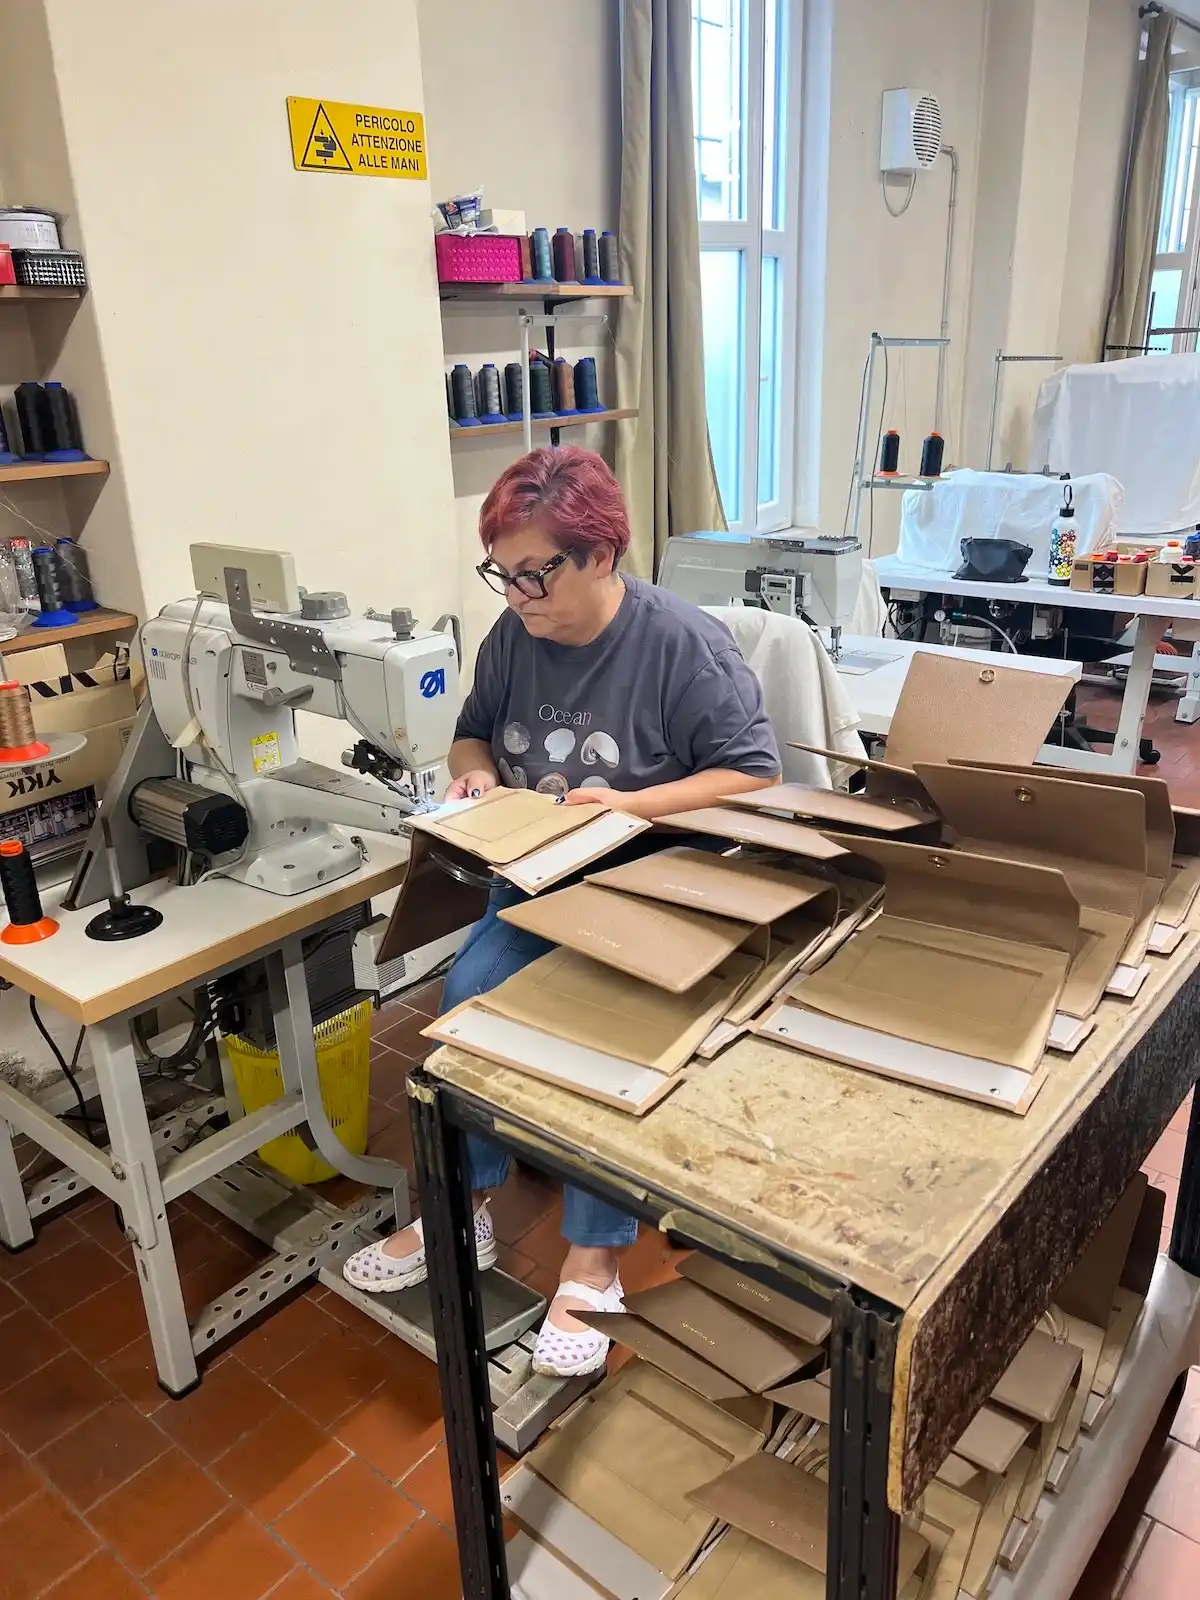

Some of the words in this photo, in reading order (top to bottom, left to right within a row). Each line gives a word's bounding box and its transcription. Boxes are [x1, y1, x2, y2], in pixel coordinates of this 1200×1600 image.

[355, 113, 415, 133] PERICOLO
[351, 133, 423, 153] ATTENZIONE
[358, 153, 388, 169] ALLE
[390, 156, 419, 172] MANI
[538, 703, 592, 726] Ocean
[6, 768, 63, 799] YKK
